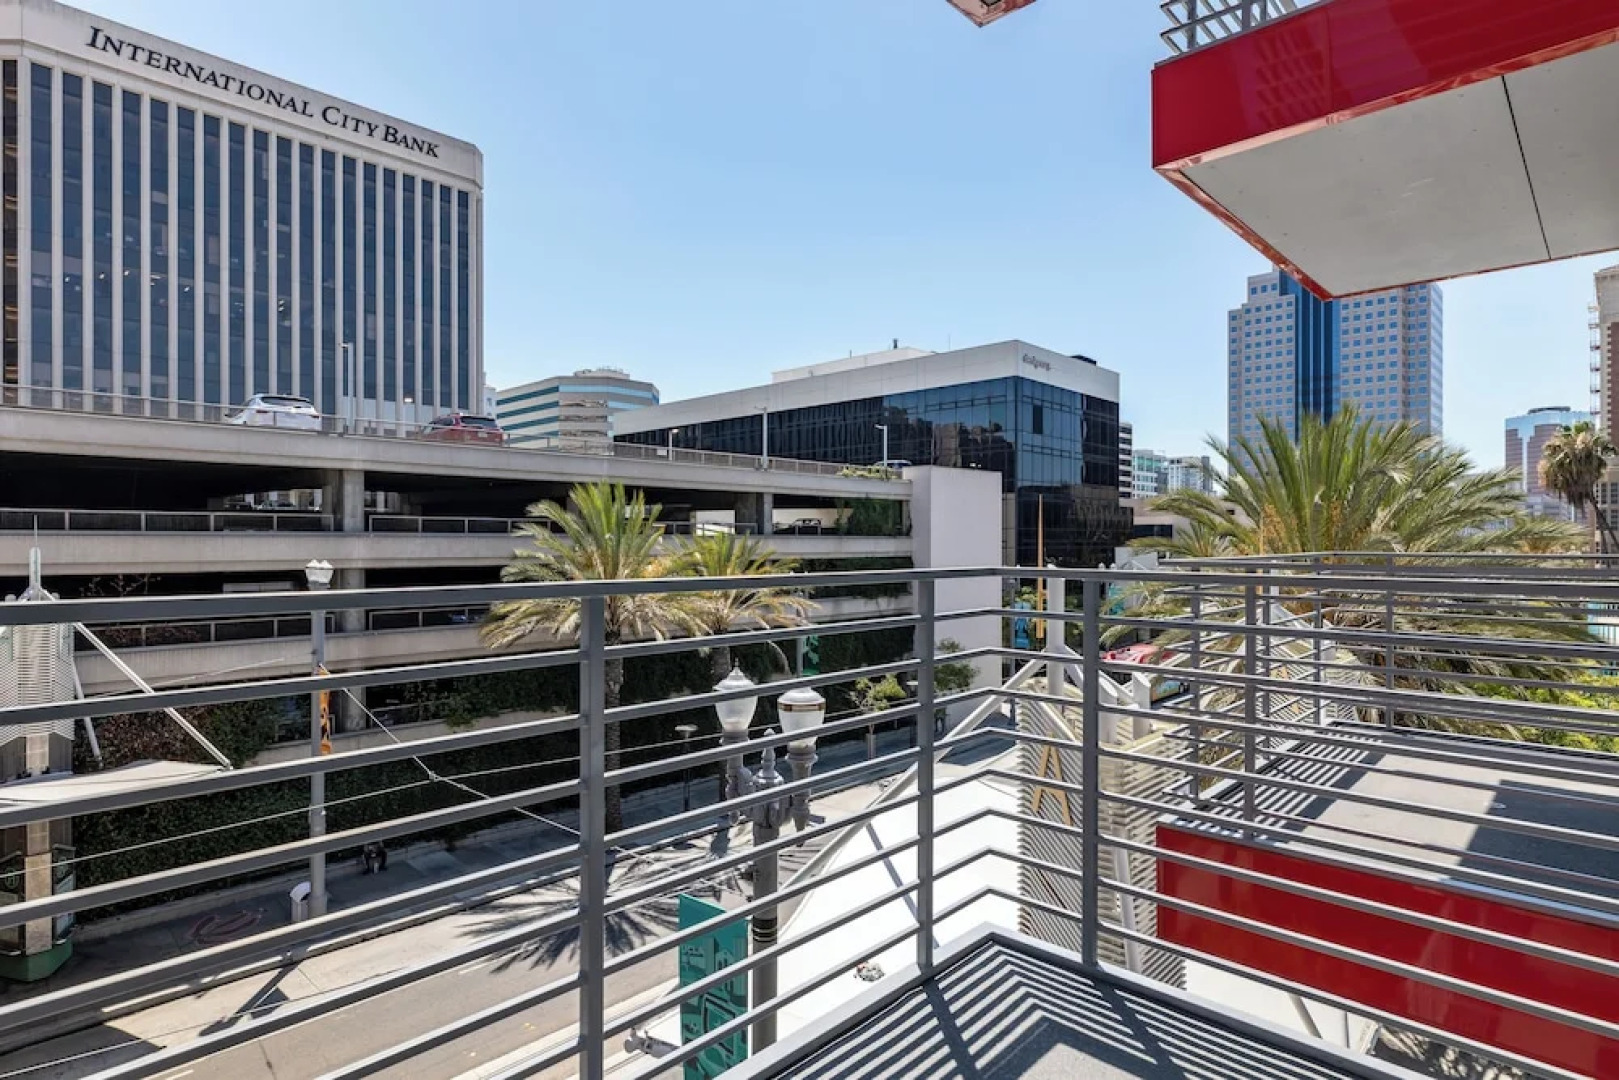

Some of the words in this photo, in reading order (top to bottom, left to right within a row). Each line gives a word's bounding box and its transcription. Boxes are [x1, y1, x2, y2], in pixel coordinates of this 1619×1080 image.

[85, 26, 314, 118] INTERNATIONAL
[321, 105, 380, 138] CITY
[381, 124, 440, 159] BANK
